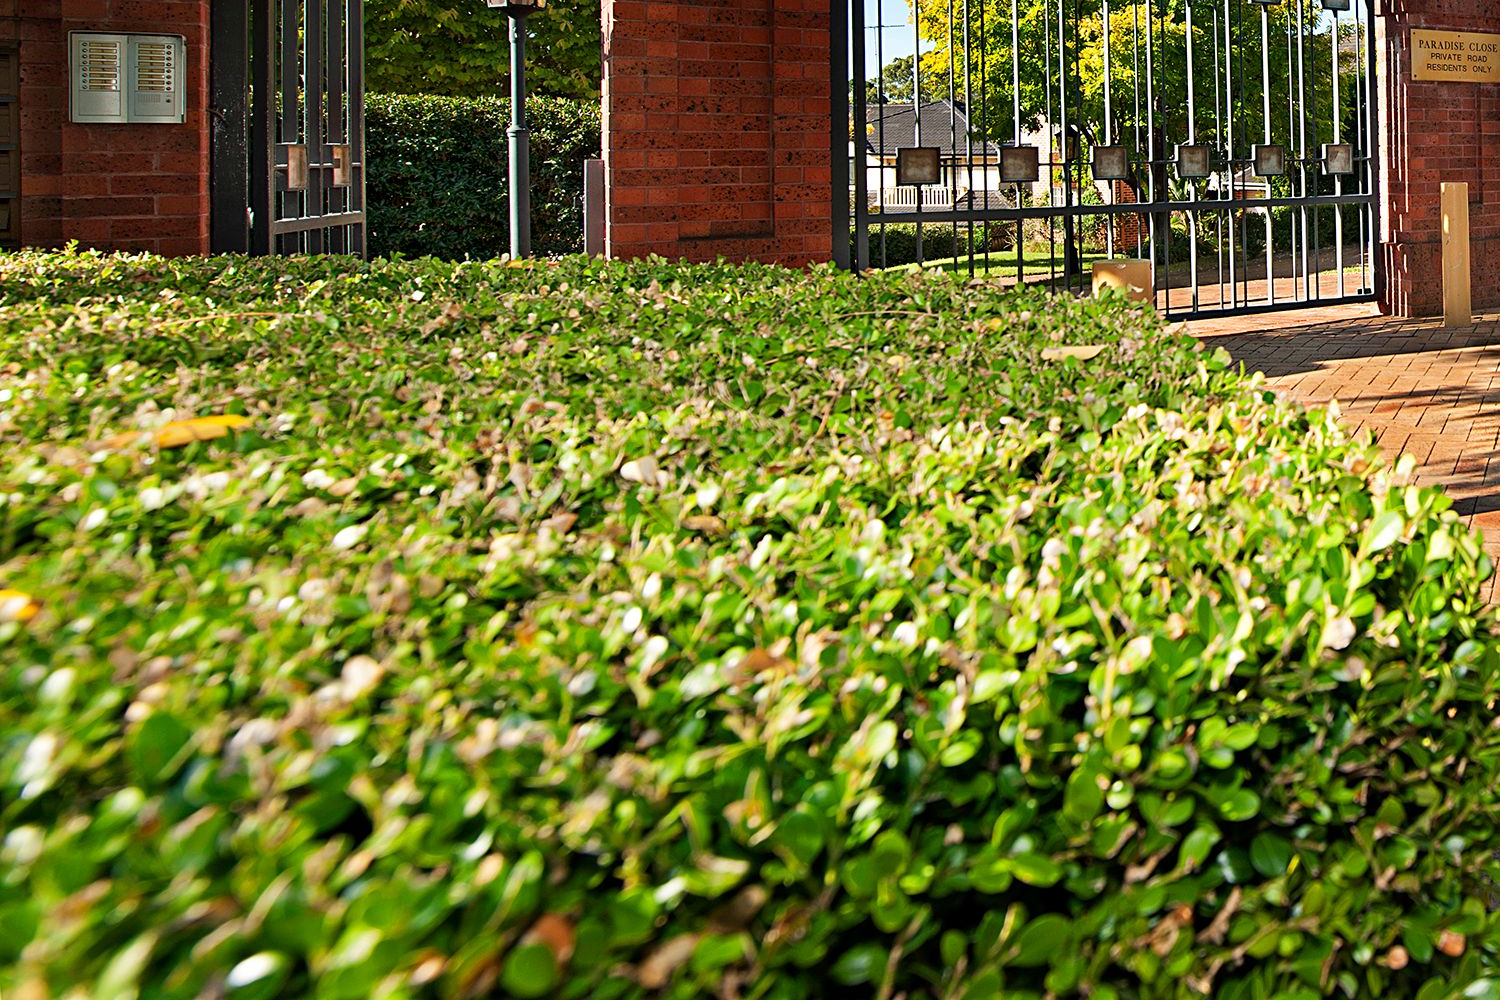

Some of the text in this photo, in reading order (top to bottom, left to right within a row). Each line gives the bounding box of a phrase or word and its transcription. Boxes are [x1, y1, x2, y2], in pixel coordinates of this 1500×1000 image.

[1419, 40, 1498, 53] PARADISE CLOSE
[1431, 52, 1488, 63] PRIVATE ROAD
[1427, 63, 1492, 74] RESIDENTS ONLY
